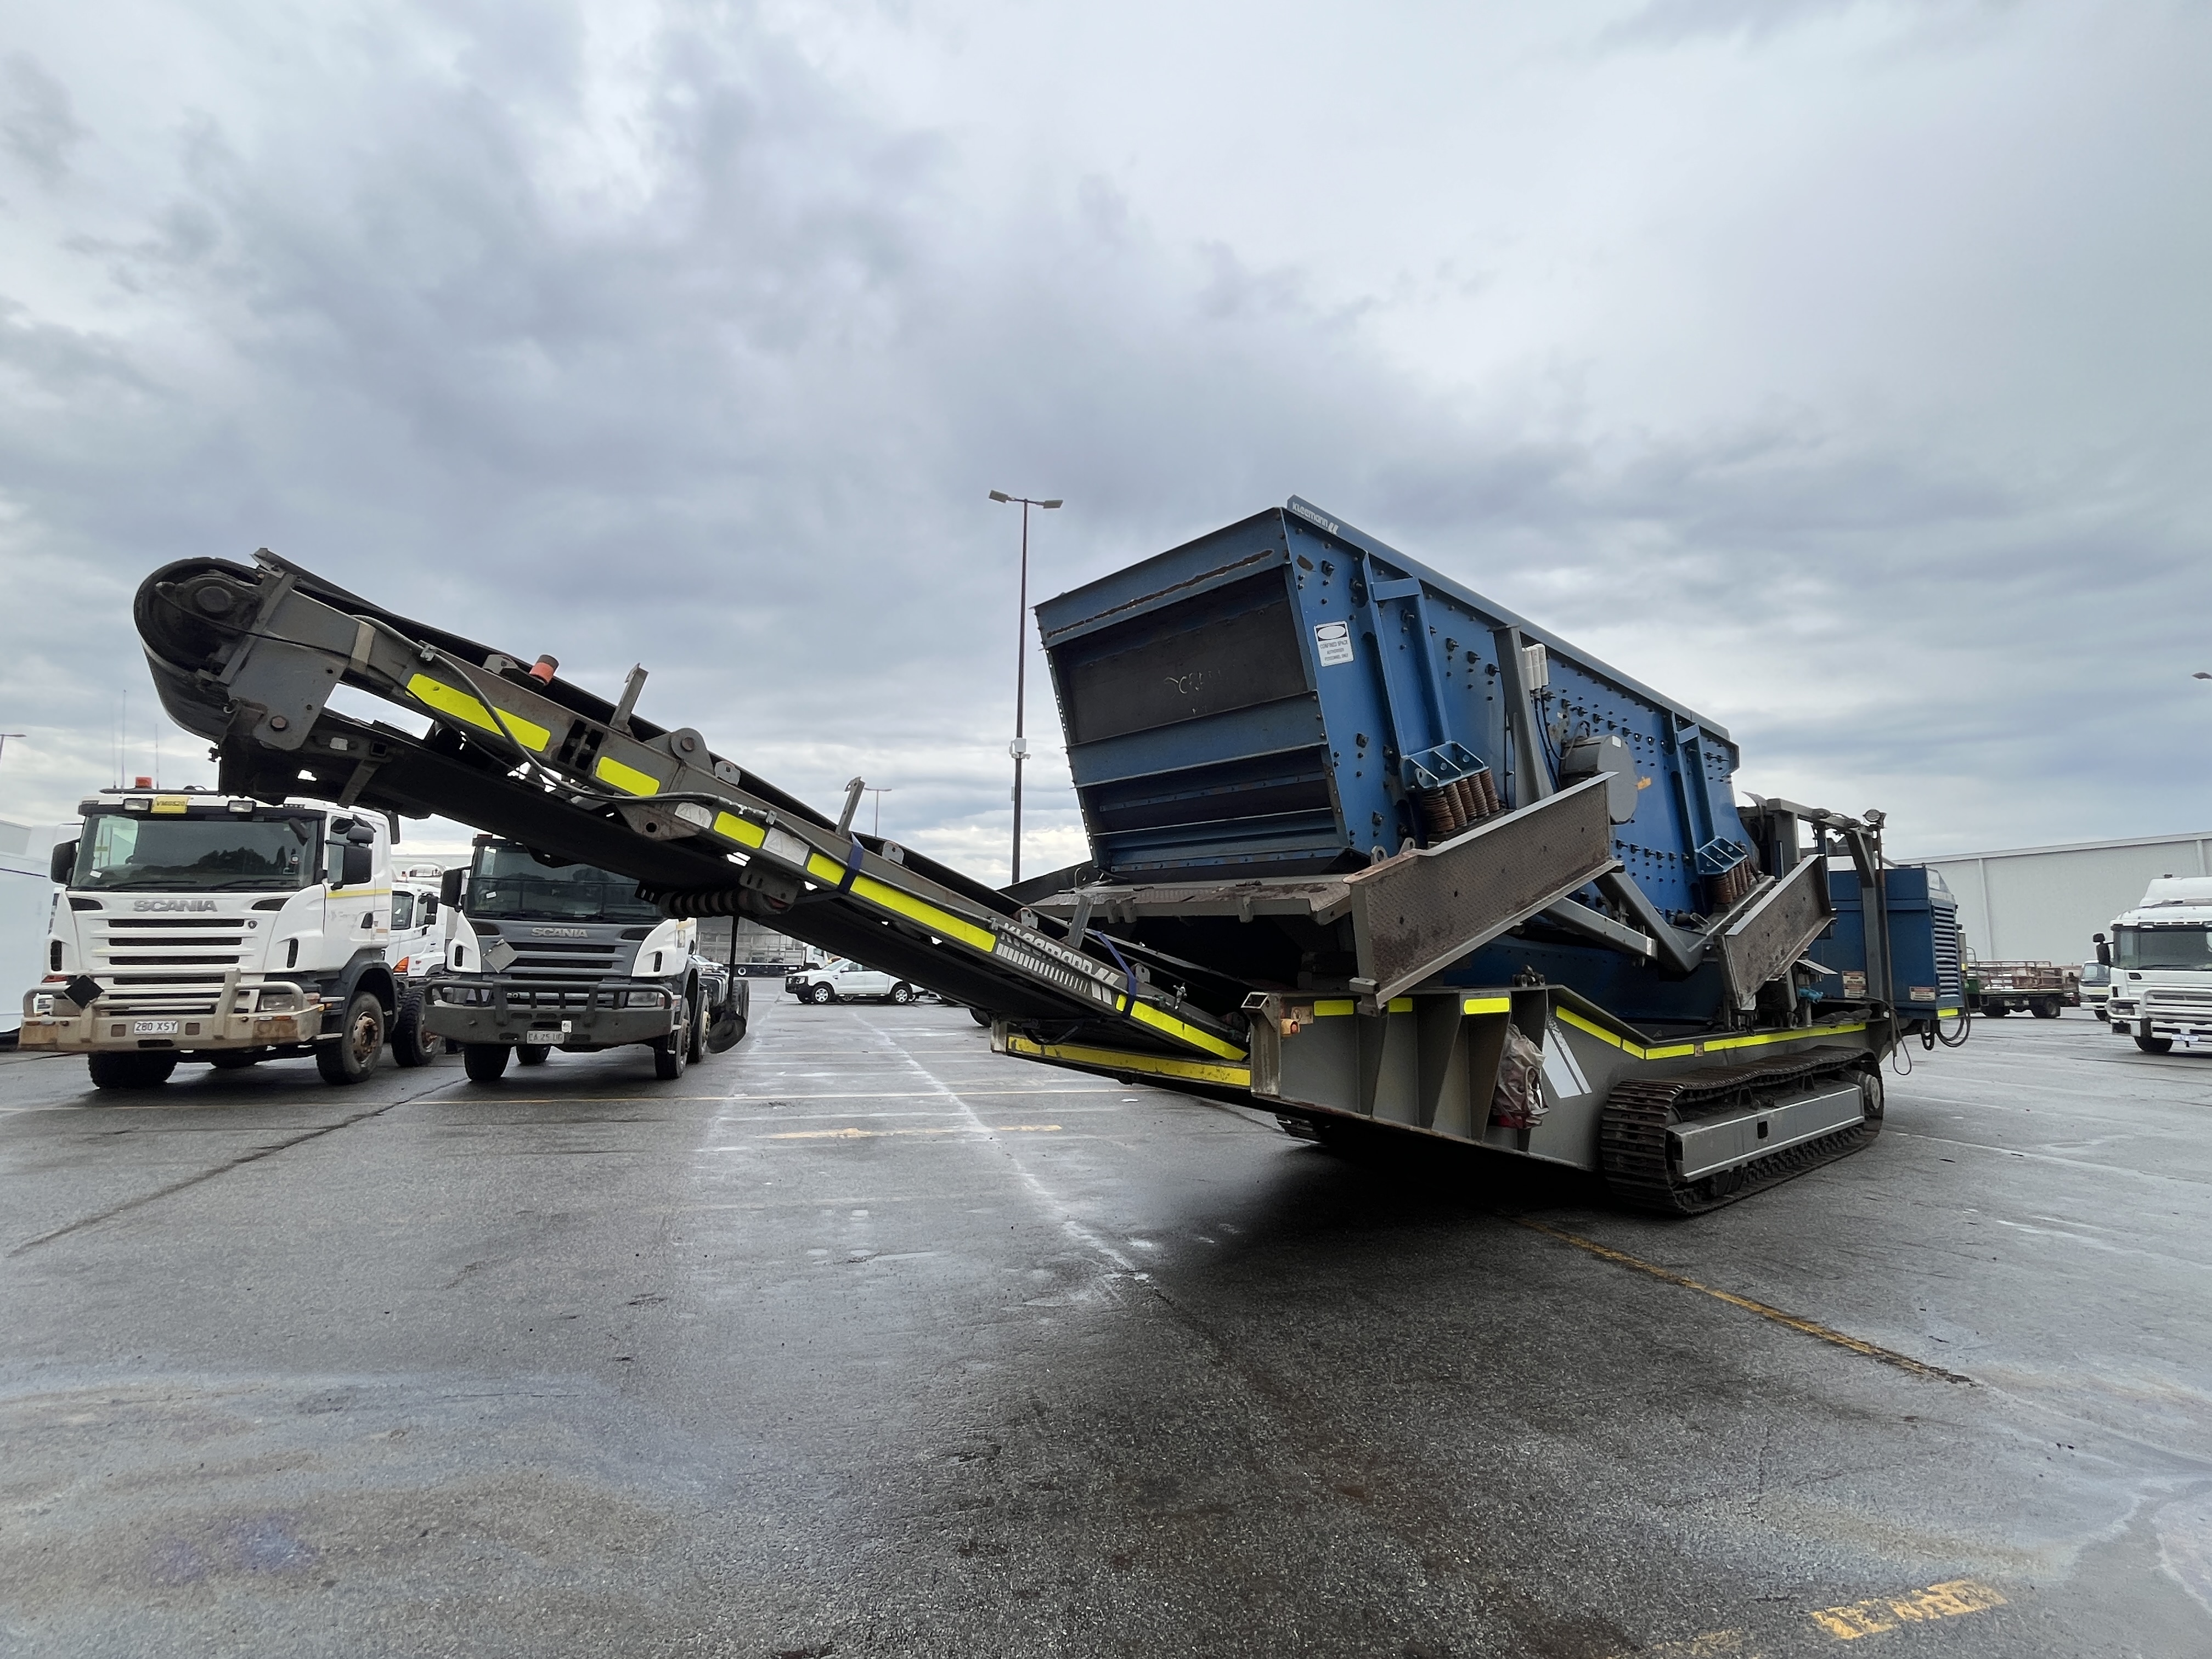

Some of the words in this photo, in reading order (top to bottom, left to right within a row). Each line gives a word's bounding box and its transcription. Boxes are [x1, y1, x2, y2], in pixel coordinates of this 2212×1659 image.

[133, 900, 218, 912] SCANIA
[531, 927, 588, 938] SCANIA
[156, 1022, 177, 1031] XSY
